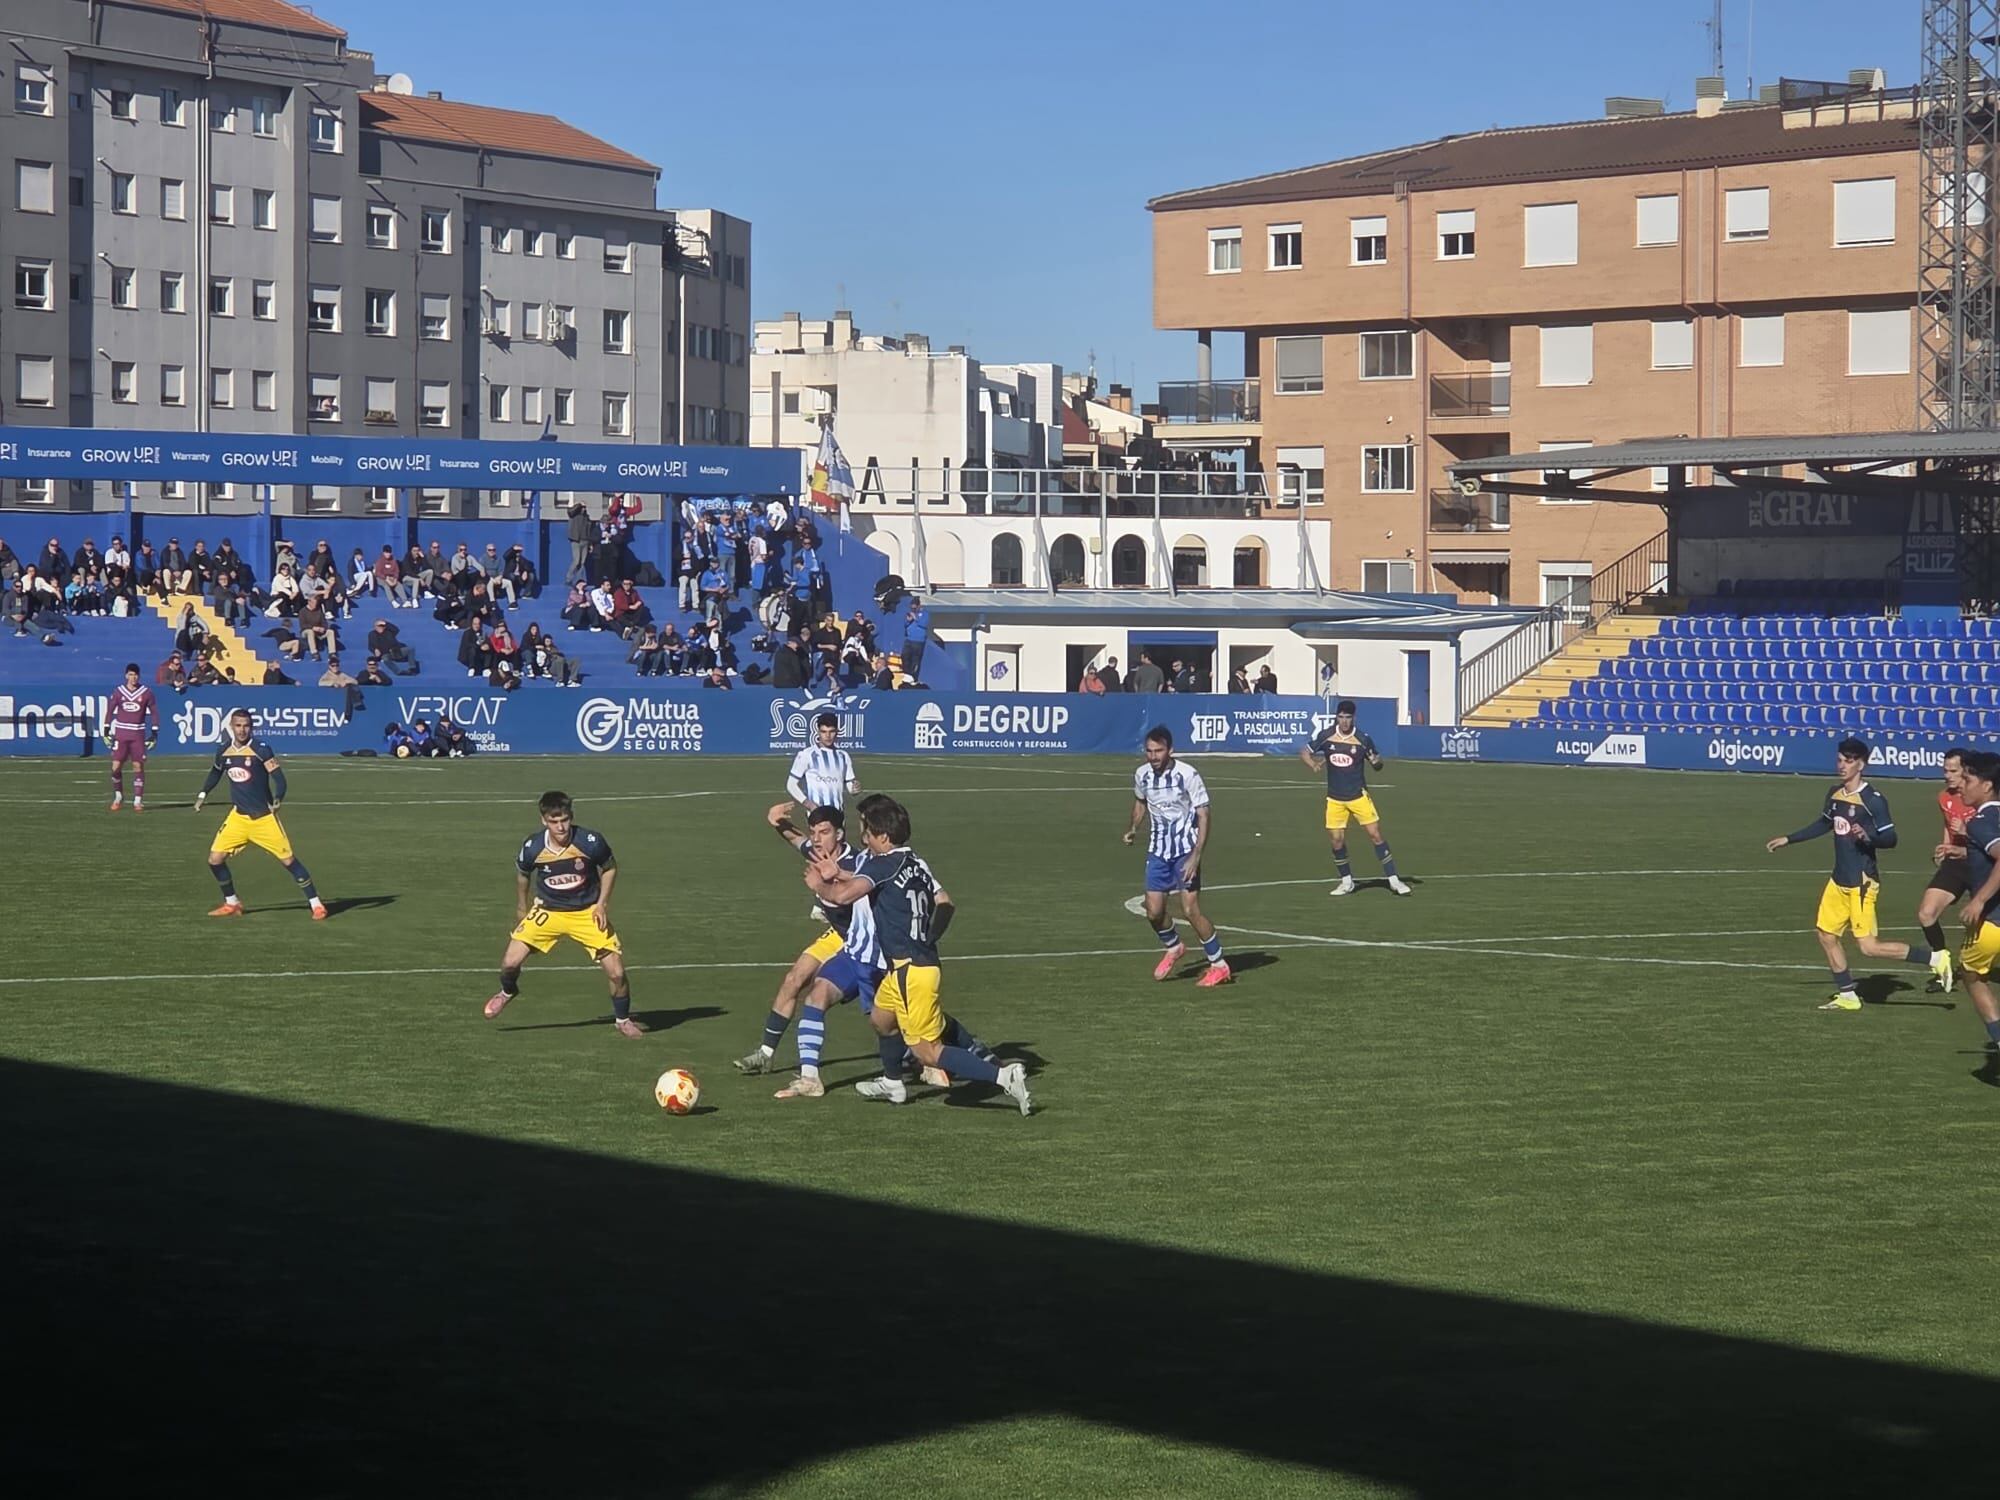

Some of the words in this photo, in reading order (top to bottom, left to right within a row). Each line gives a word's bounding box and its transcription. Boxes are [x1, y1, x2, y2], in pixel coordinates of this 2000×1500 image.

[27, 448, 71, 458] Insurance
[82, 449, 131, 462] GROW
[134, 446, 154, 459] UP
[172, 452, 210, 463] Warranty
[222, 453, 269, 466] GROW
[272, 450, 291, 463] UP
[311, 455, 343, 466] Mobility
[357, 457, 403, 470] GROW
[406, 455, 425, 467] UP
[440, 459, 479, 469] Insurance
[490, 460, 534, 473] GROW
[537, 458, 555, 470] UP
[572, 462, 607, 473] Warranty
[618, 463, 660, 476] GROW
[664, 461, 681, 473] UP
[700, 466, 728, 477] Mobility
[248, 707, 348, 728] SYSTEM
[398, 696, 507, 725] VERICAT
[627, 700, 699, 721] Mutua
[953, 705, 1069, 733] DEGRUP
[1233, 711, 1308, 720] TRANSPORTES
[252, 729, 286, 737] SISTEMAS
[287, 729, 298, 737] DE
[299, 729, 339, 737] SEGURIDAD
[624, 721, 703, 742] Levante
[1233, 723, 1242, 736] A.
[1244, 723, 1289, 736] PASCUAL
[1290, 723, 1308, 736] S.L.
[624, 741, 701, 752] SEGUROS
[952, 738, 1014, 748] CONSTRUCCIÓN
[1024, 740, 1068, 748] REFORMAS
[1605, 743, 1637, 756] LIMP
[1706, 741, 1784, 766] Digicopy
[1885, 746, 1945, 770] Replus
[526, 907, 550, 927] 30
[906, 889, 929, 942] 10
